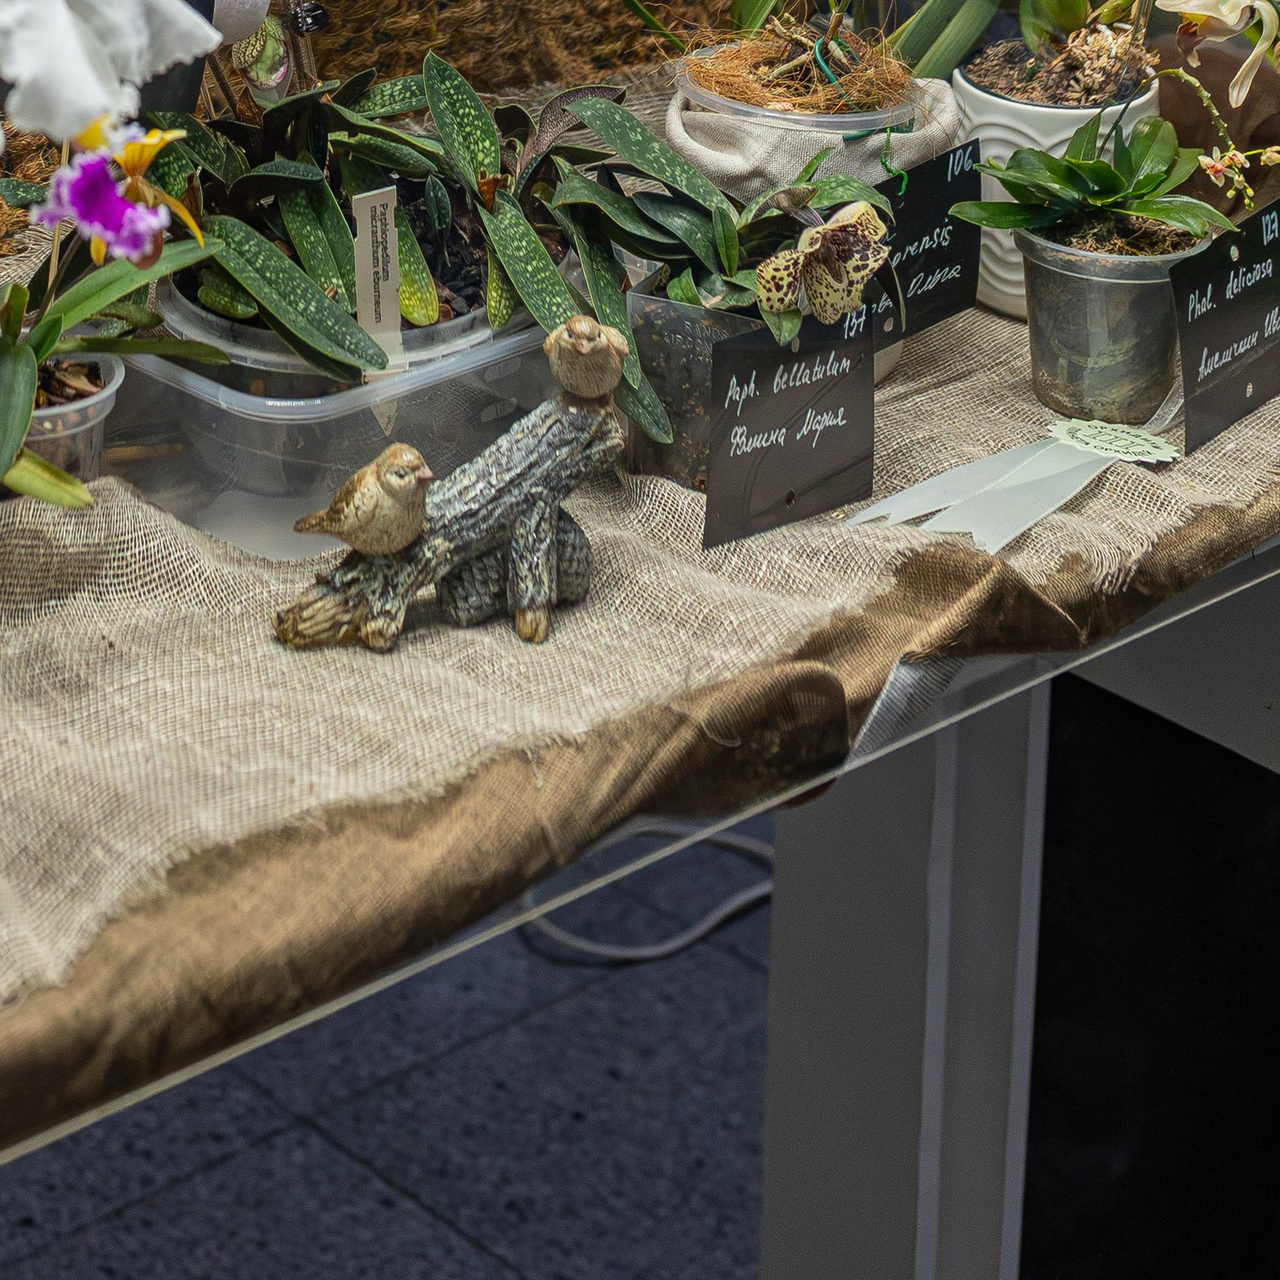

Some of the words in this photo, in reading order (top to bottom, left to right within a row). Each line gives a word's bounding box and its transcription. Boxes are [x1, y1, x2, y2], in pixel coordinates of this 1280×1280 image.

[1188, 283, 1217, 323] Phal.
[1225, 257, 1273, 300] deliciosa
[725, 370, 760, 417] Paph.
[796, 407, 847, 449] Мария
